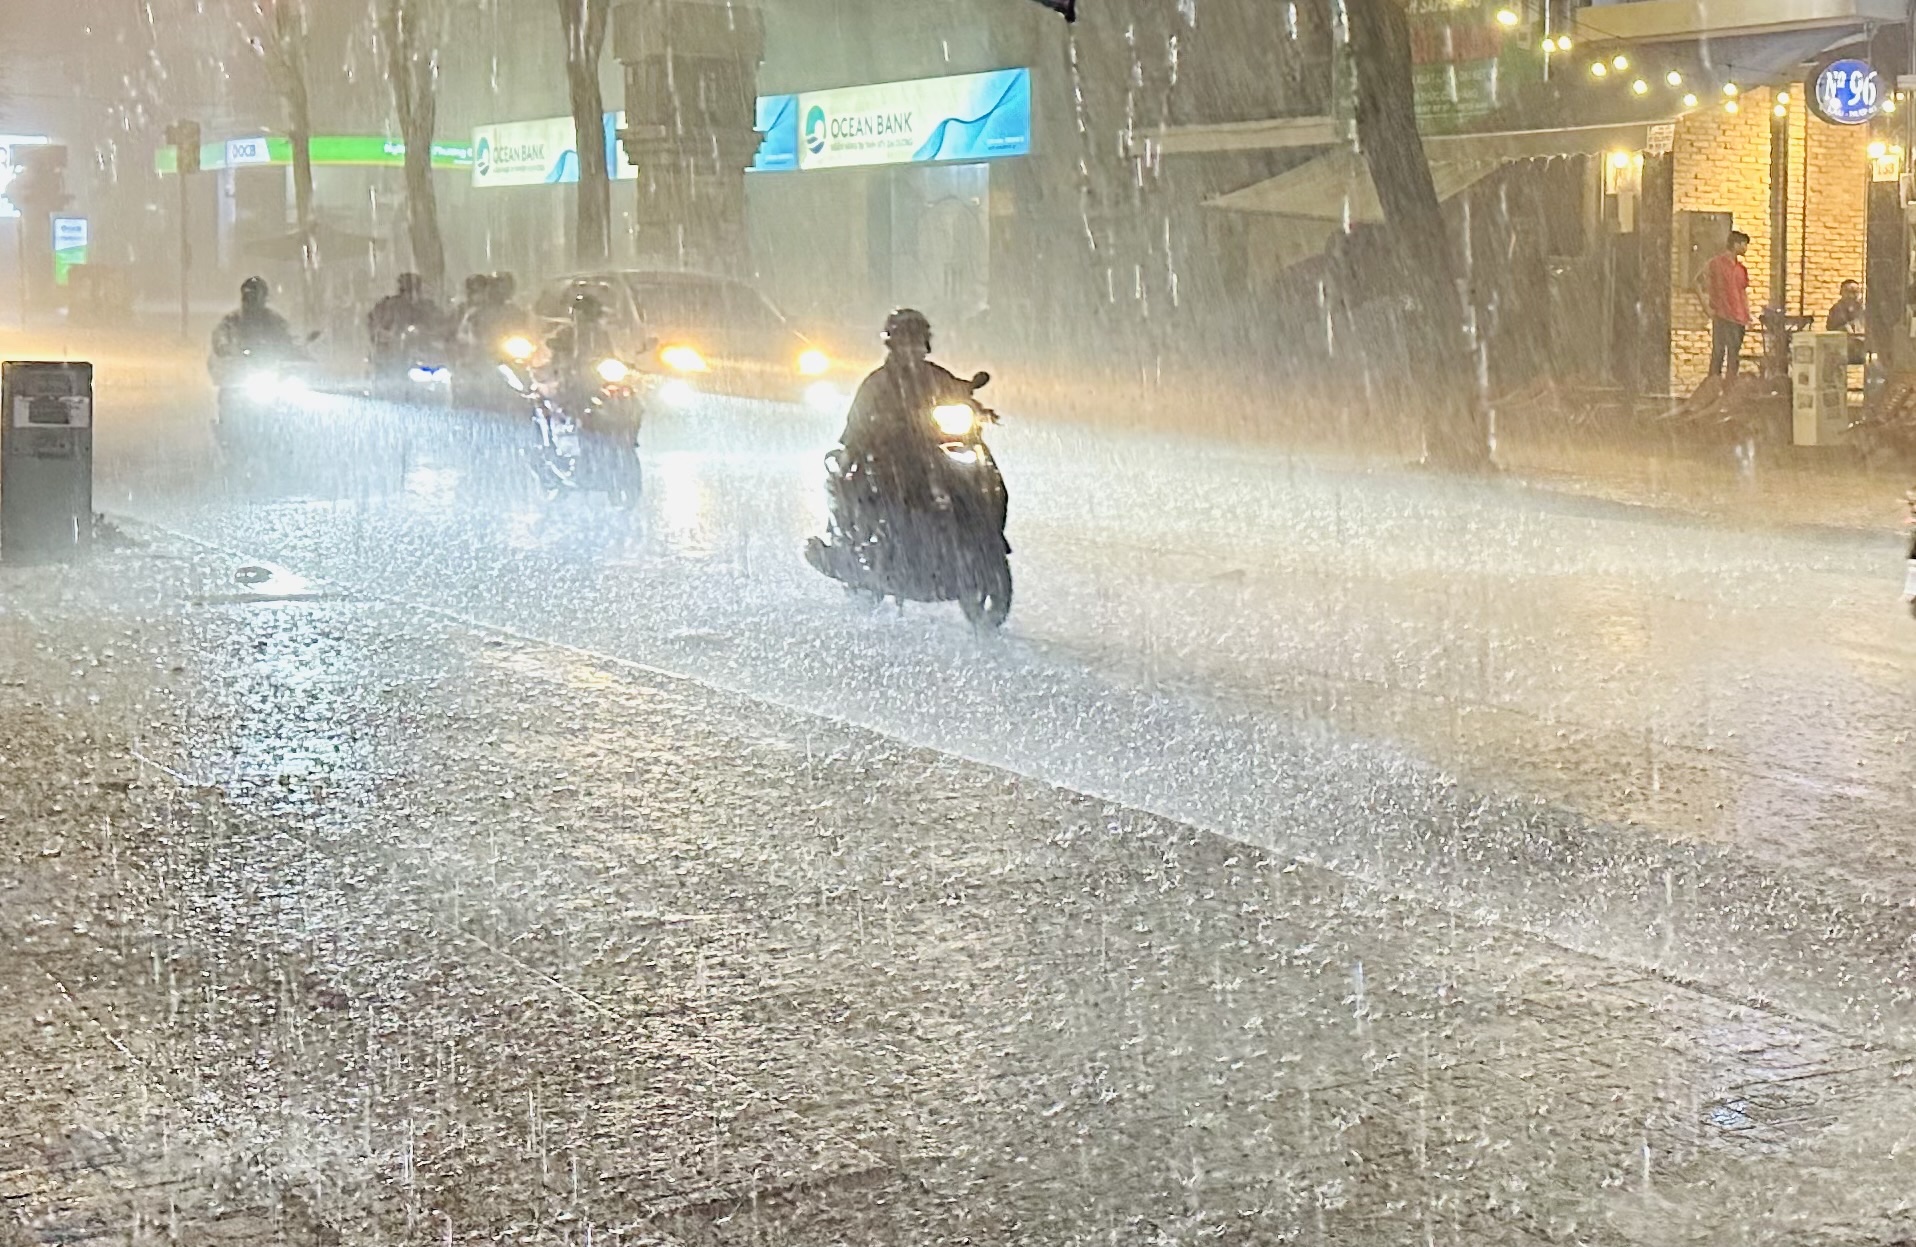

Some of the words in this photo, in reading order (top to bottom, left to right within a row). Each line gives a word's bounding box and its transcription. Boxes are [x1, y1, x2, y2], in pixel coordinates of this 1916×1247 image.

[1847, 70, 1878, 106] 96
[831, 116, 873, 139] OCEAN
[877, 111, 913, 135] BANK
[493, 145, 520, 164] OCEAN
[521, 144, 545, 161] BANK
